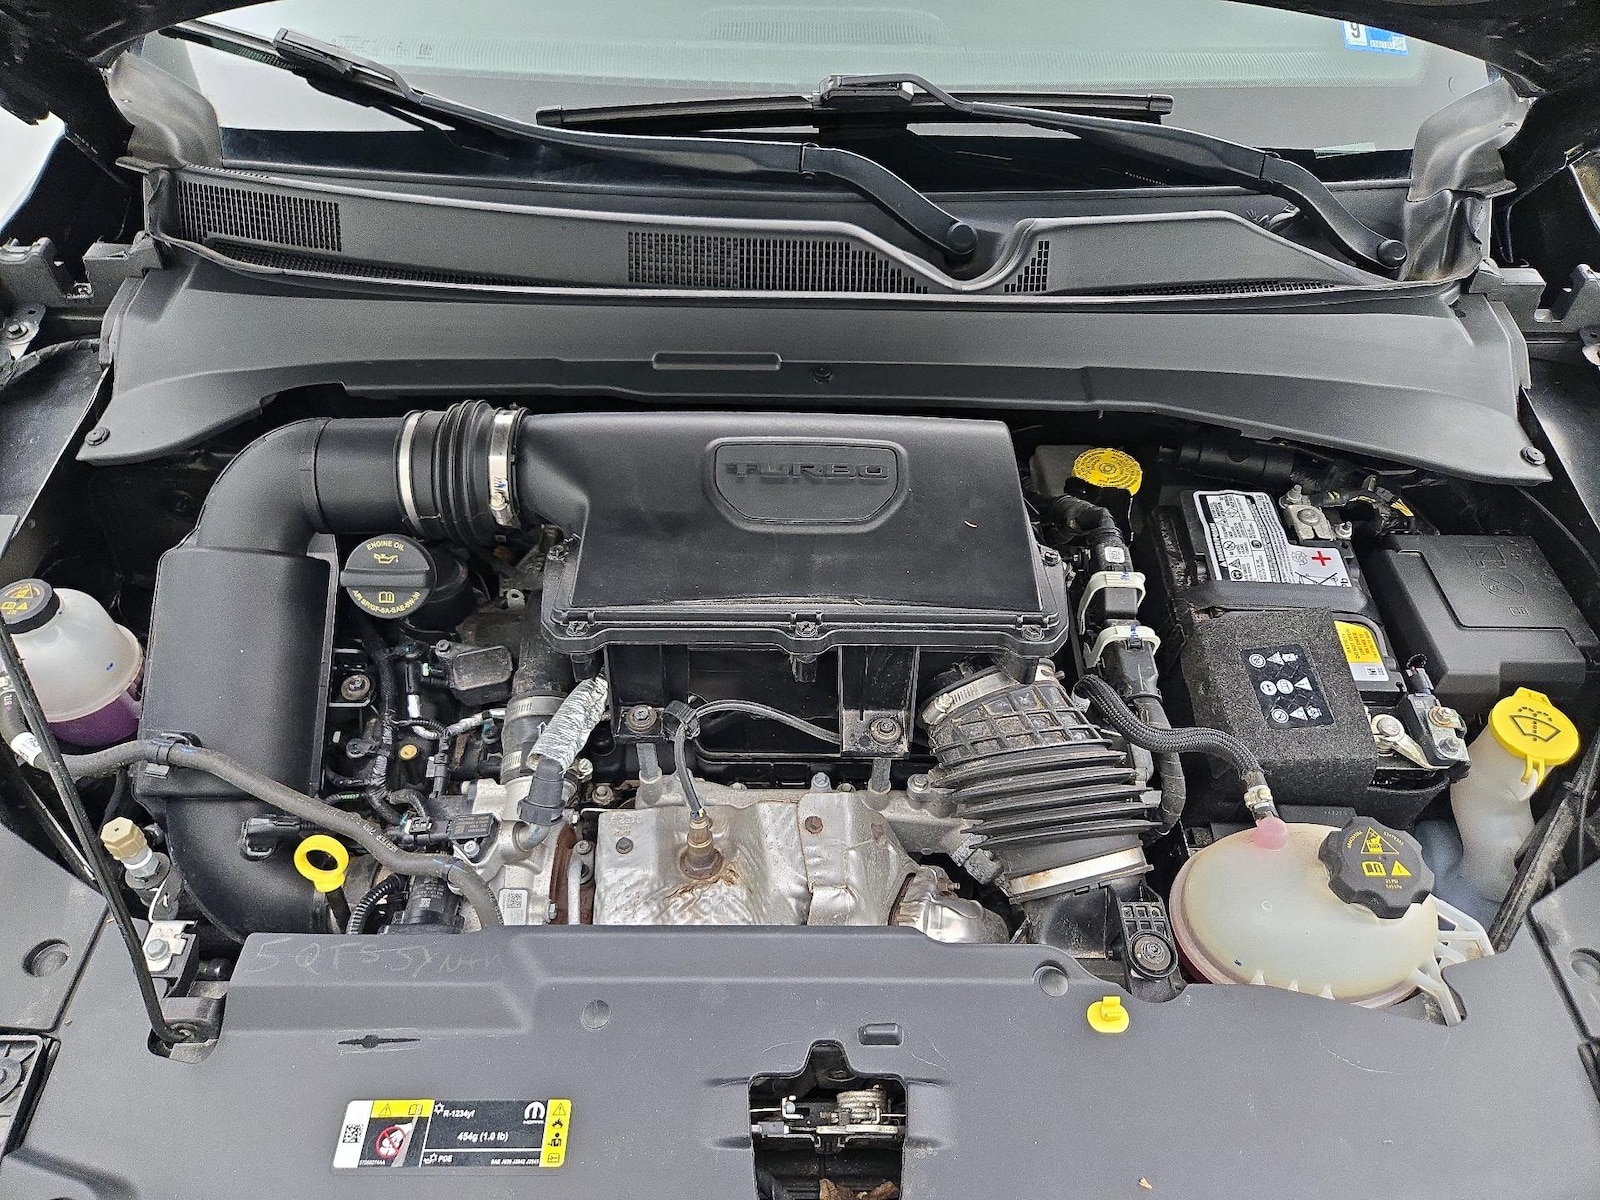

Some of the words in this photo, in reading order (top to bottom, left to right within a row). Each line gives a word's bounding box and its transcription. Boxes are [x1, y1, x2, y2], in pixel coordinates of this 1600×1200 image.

[726, 462, 889, 482] TURBO
[366, 540, 393, 551] ENGINE
[393, 540, 406, 551] OIL
[443, 1109, 476, 1120] R-1234yf
[457, 1132, 479, 1142] 454g
[480, 1132, 495, 1142] (1.0
[497, 1132, 509, 1142] lb)
